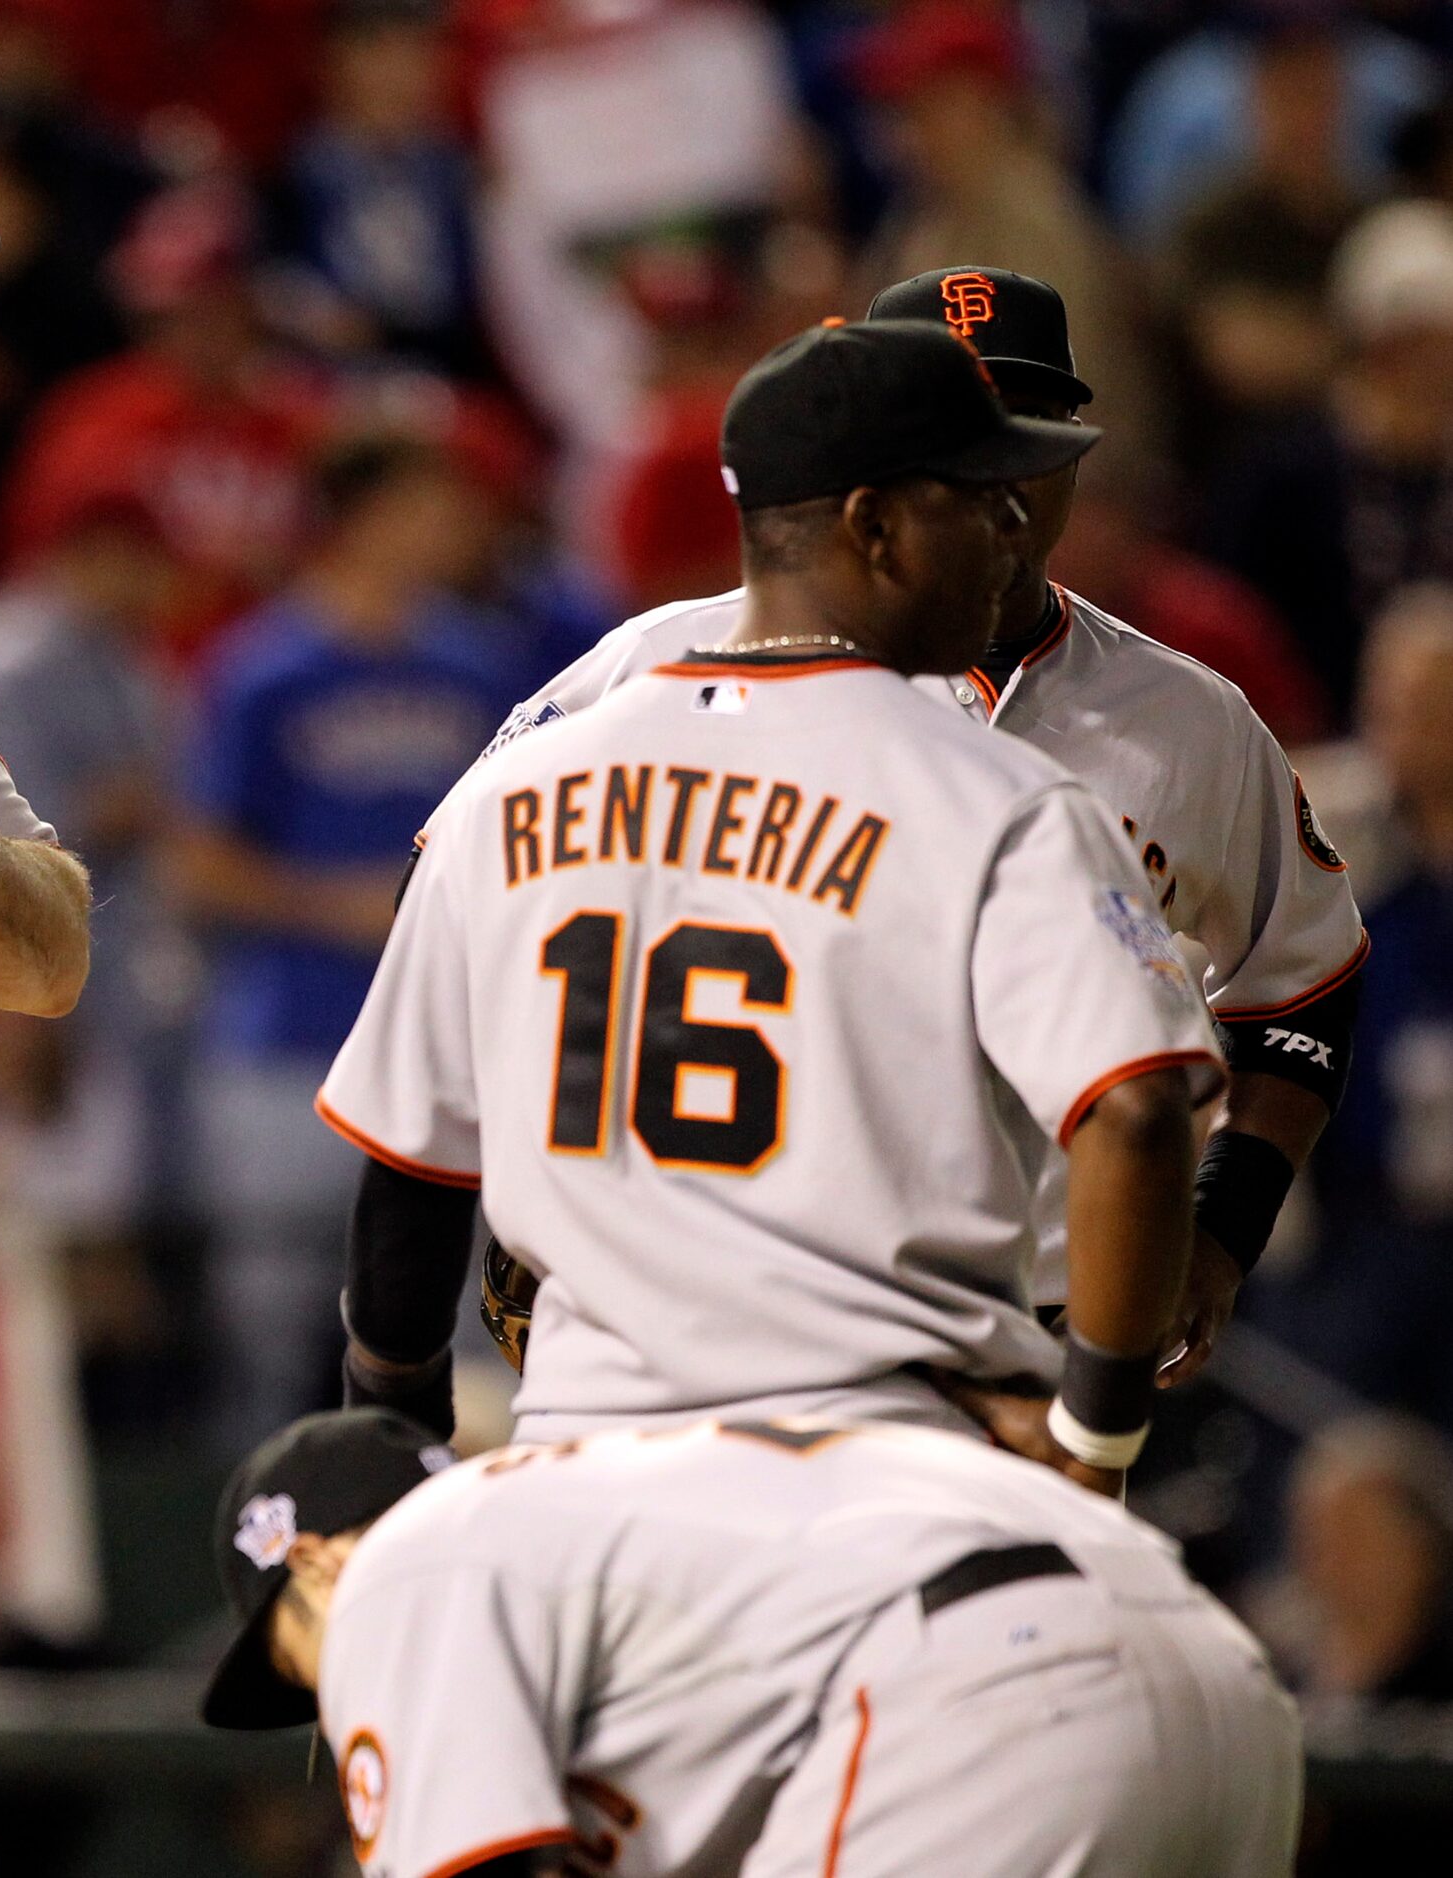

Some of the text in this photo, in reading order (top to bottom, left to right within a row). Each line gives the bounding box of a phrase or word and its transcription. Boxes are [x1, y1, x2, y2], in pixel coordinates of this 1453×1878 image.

[940, 271, 997, 336] SF
[502, 763, 892, 919] RENTERIA
[539, 907, 796, 1177] 16
[1263, 1026, 1333, 1069] TPX
